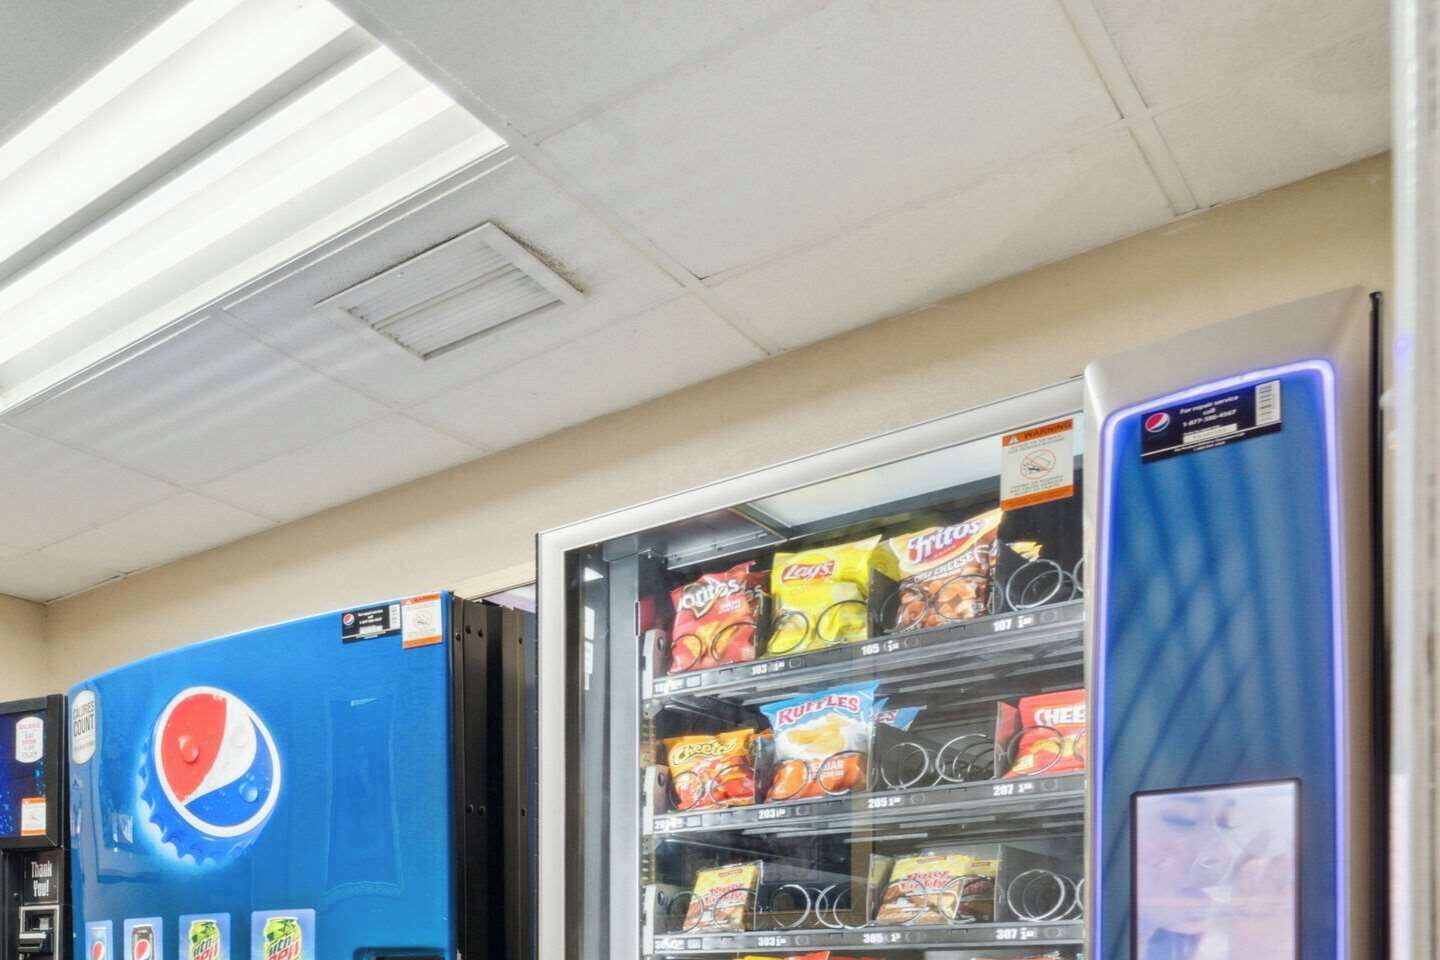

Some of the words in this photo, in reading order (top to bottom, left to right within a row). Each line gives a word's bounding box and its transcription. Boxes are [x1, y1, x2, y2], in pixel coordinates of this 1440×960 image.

[908, 520, 981, 560] Fritos
[776, 695, 860, 726] RUFFLES
[31, 860, 53, 878] Thank
[33, 879, 50, 898] You!
